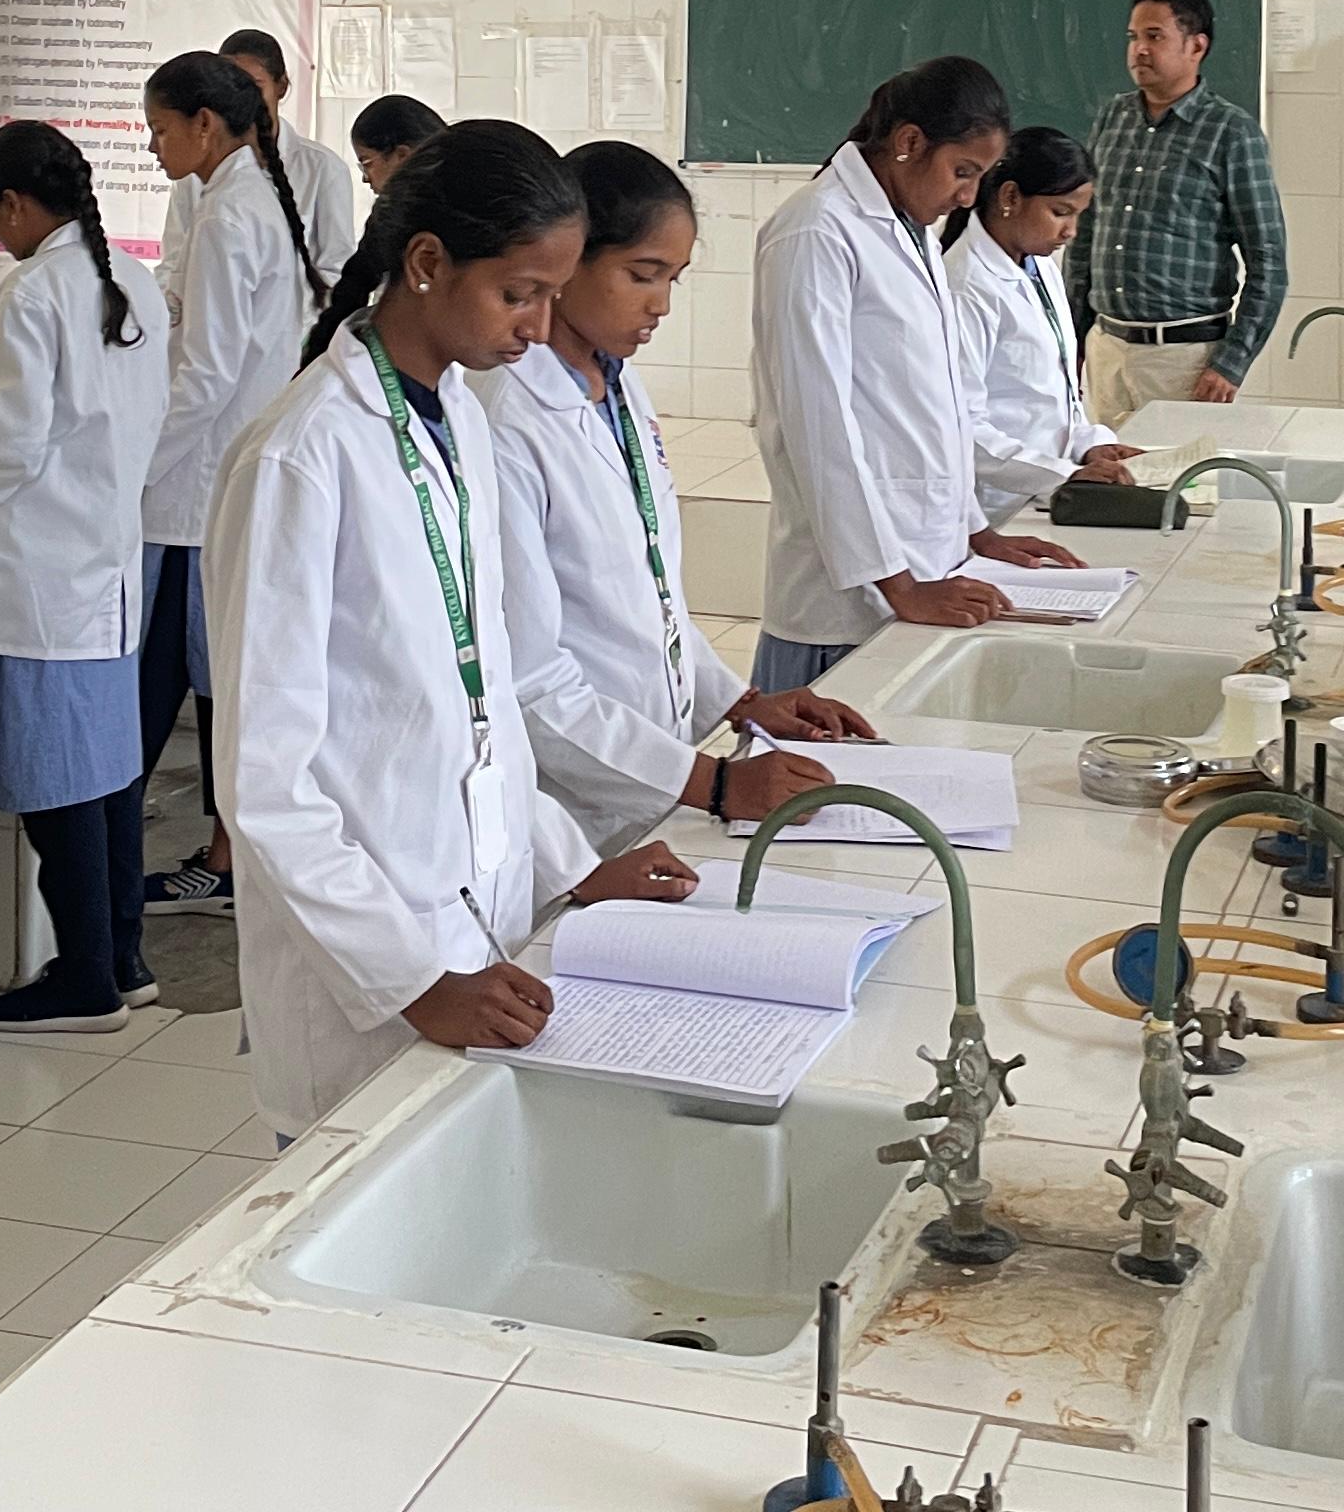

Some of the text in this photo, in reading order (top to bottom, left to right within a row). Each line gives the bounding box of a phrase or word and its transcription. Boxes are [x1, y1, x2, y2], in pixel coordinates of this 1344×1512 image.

[71, 119, 82, 128] of
[86, 119, 132, 132] Normality
[134, 120, 146, 133] by
[419, 491, 445, 552] PHARMACY
[435, 551, 449, 568] OF
[443, 568, 462, 615] COLLEGE
[450, 613, 469, 643] KVK
